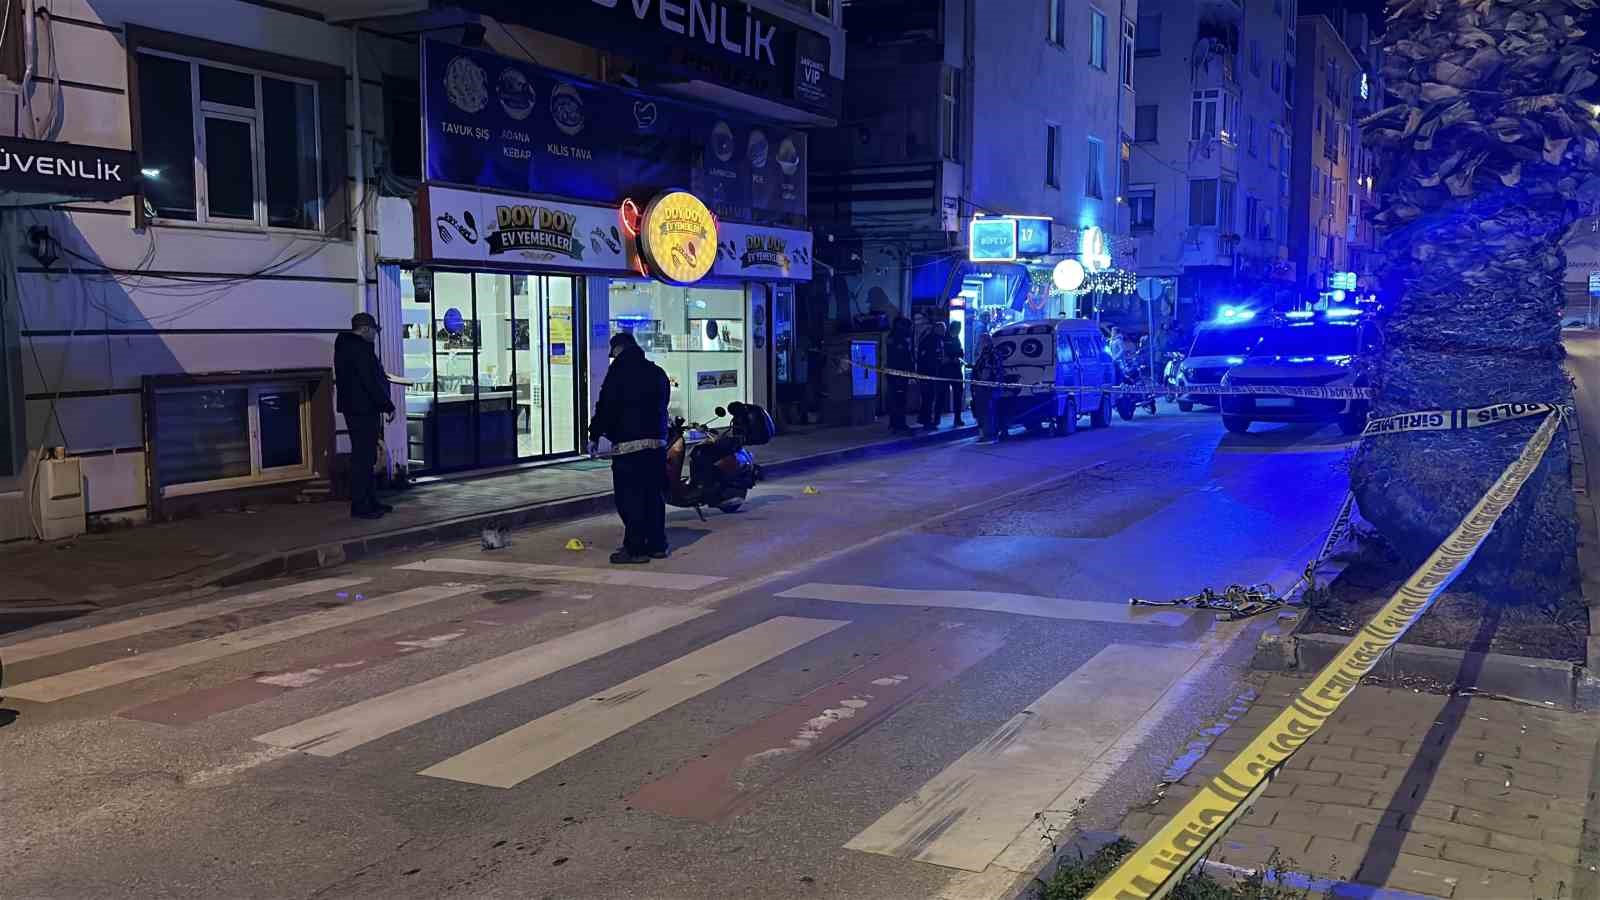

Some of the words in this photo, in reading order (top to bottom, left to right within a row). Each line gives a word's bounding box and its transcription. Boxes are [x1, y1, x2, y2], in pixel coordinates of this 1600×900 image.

[592, 0, 776, 66] VENLİK
[440, 121, 473, 137] TAVUK
[496, 205, 537, 229] DOY
[538, 207, 576, 236] DOY
[501, 231, 516, 247] EV
